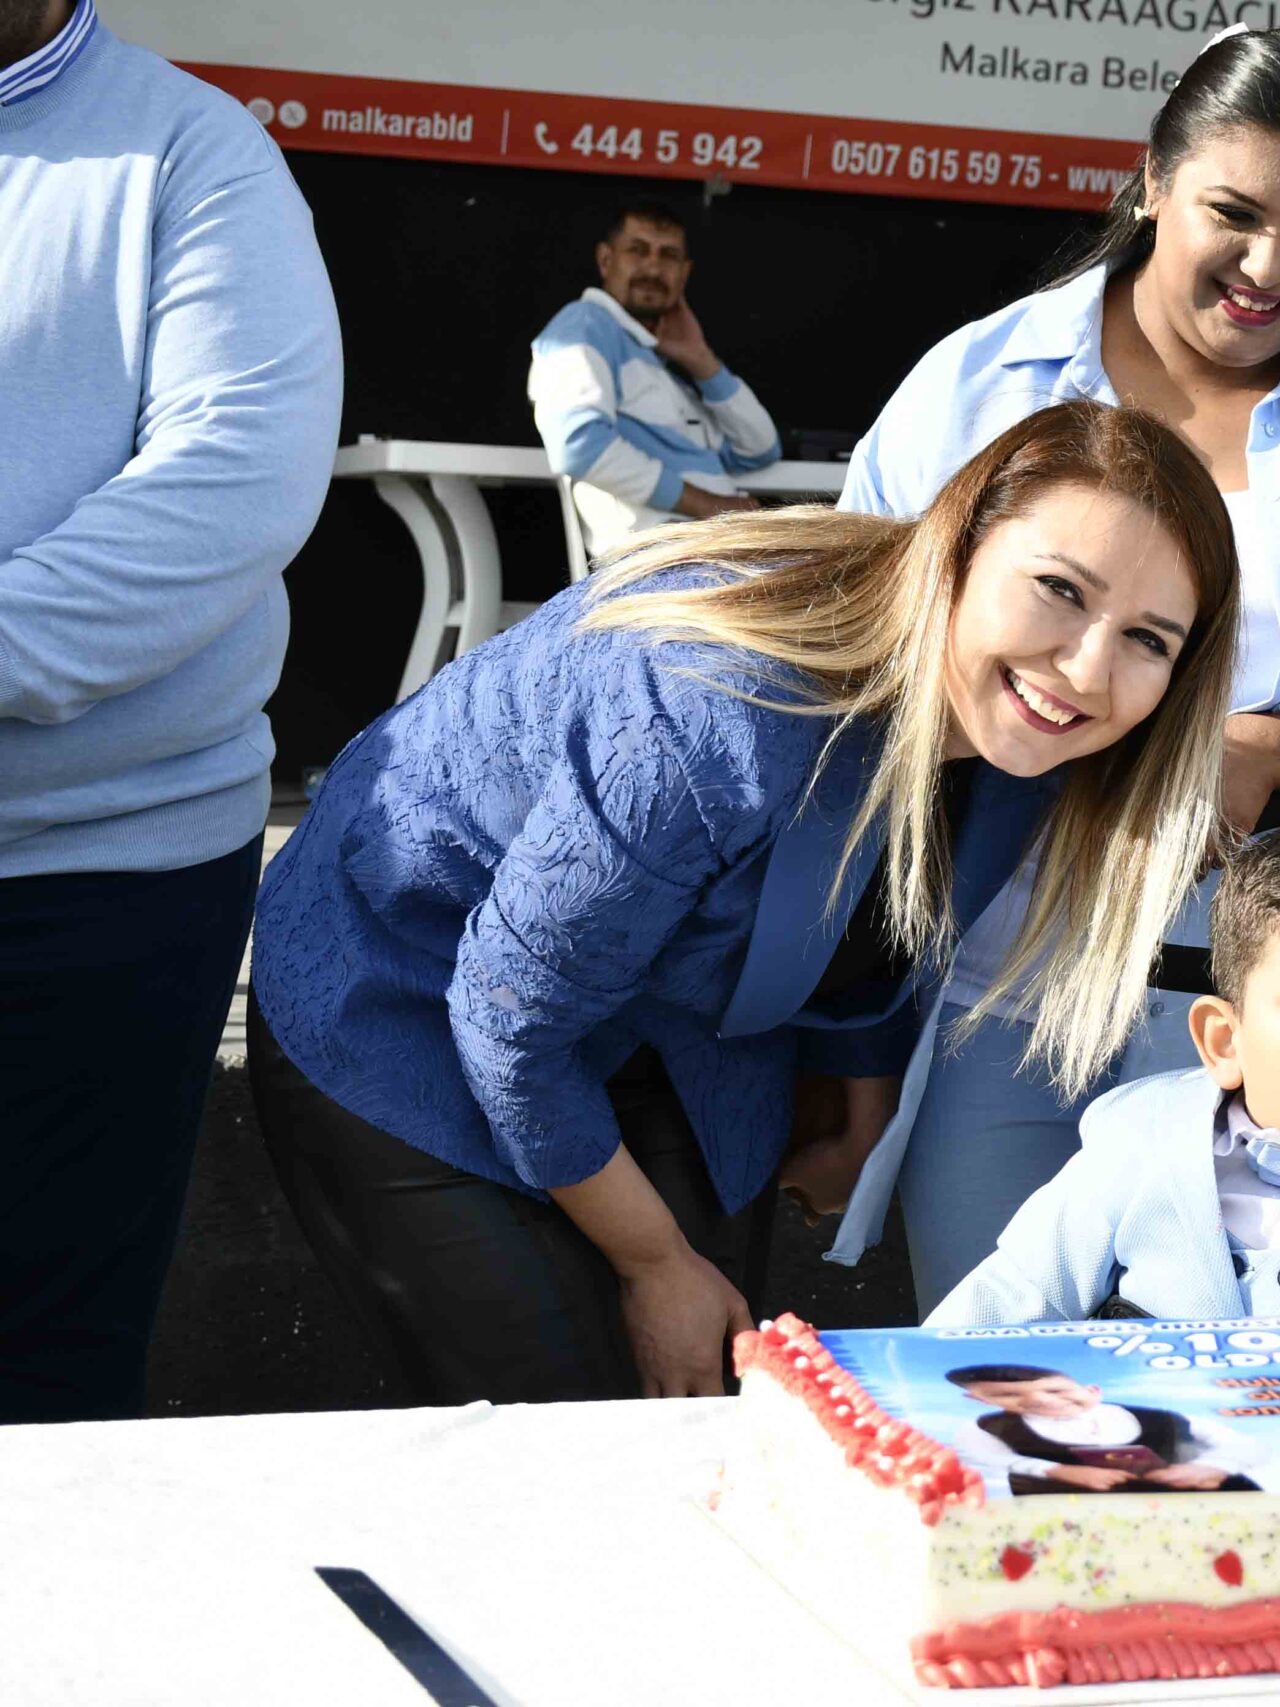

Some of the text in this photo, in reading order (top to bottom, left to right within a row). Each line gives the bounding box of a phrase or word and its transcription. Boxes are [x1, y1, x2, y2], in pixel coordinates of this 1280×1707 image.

[940, 41, 1089, 86] Malkara
[321, 106, 474, 142] malkarabld
[570, 123, 764, 169] 444 5 942
[831, 139, 902, 177] 0507
[908, 146, 960, 182] 615
[966, 151, 1001, 186] 59
[1009, 154, 1042, 189] 75
